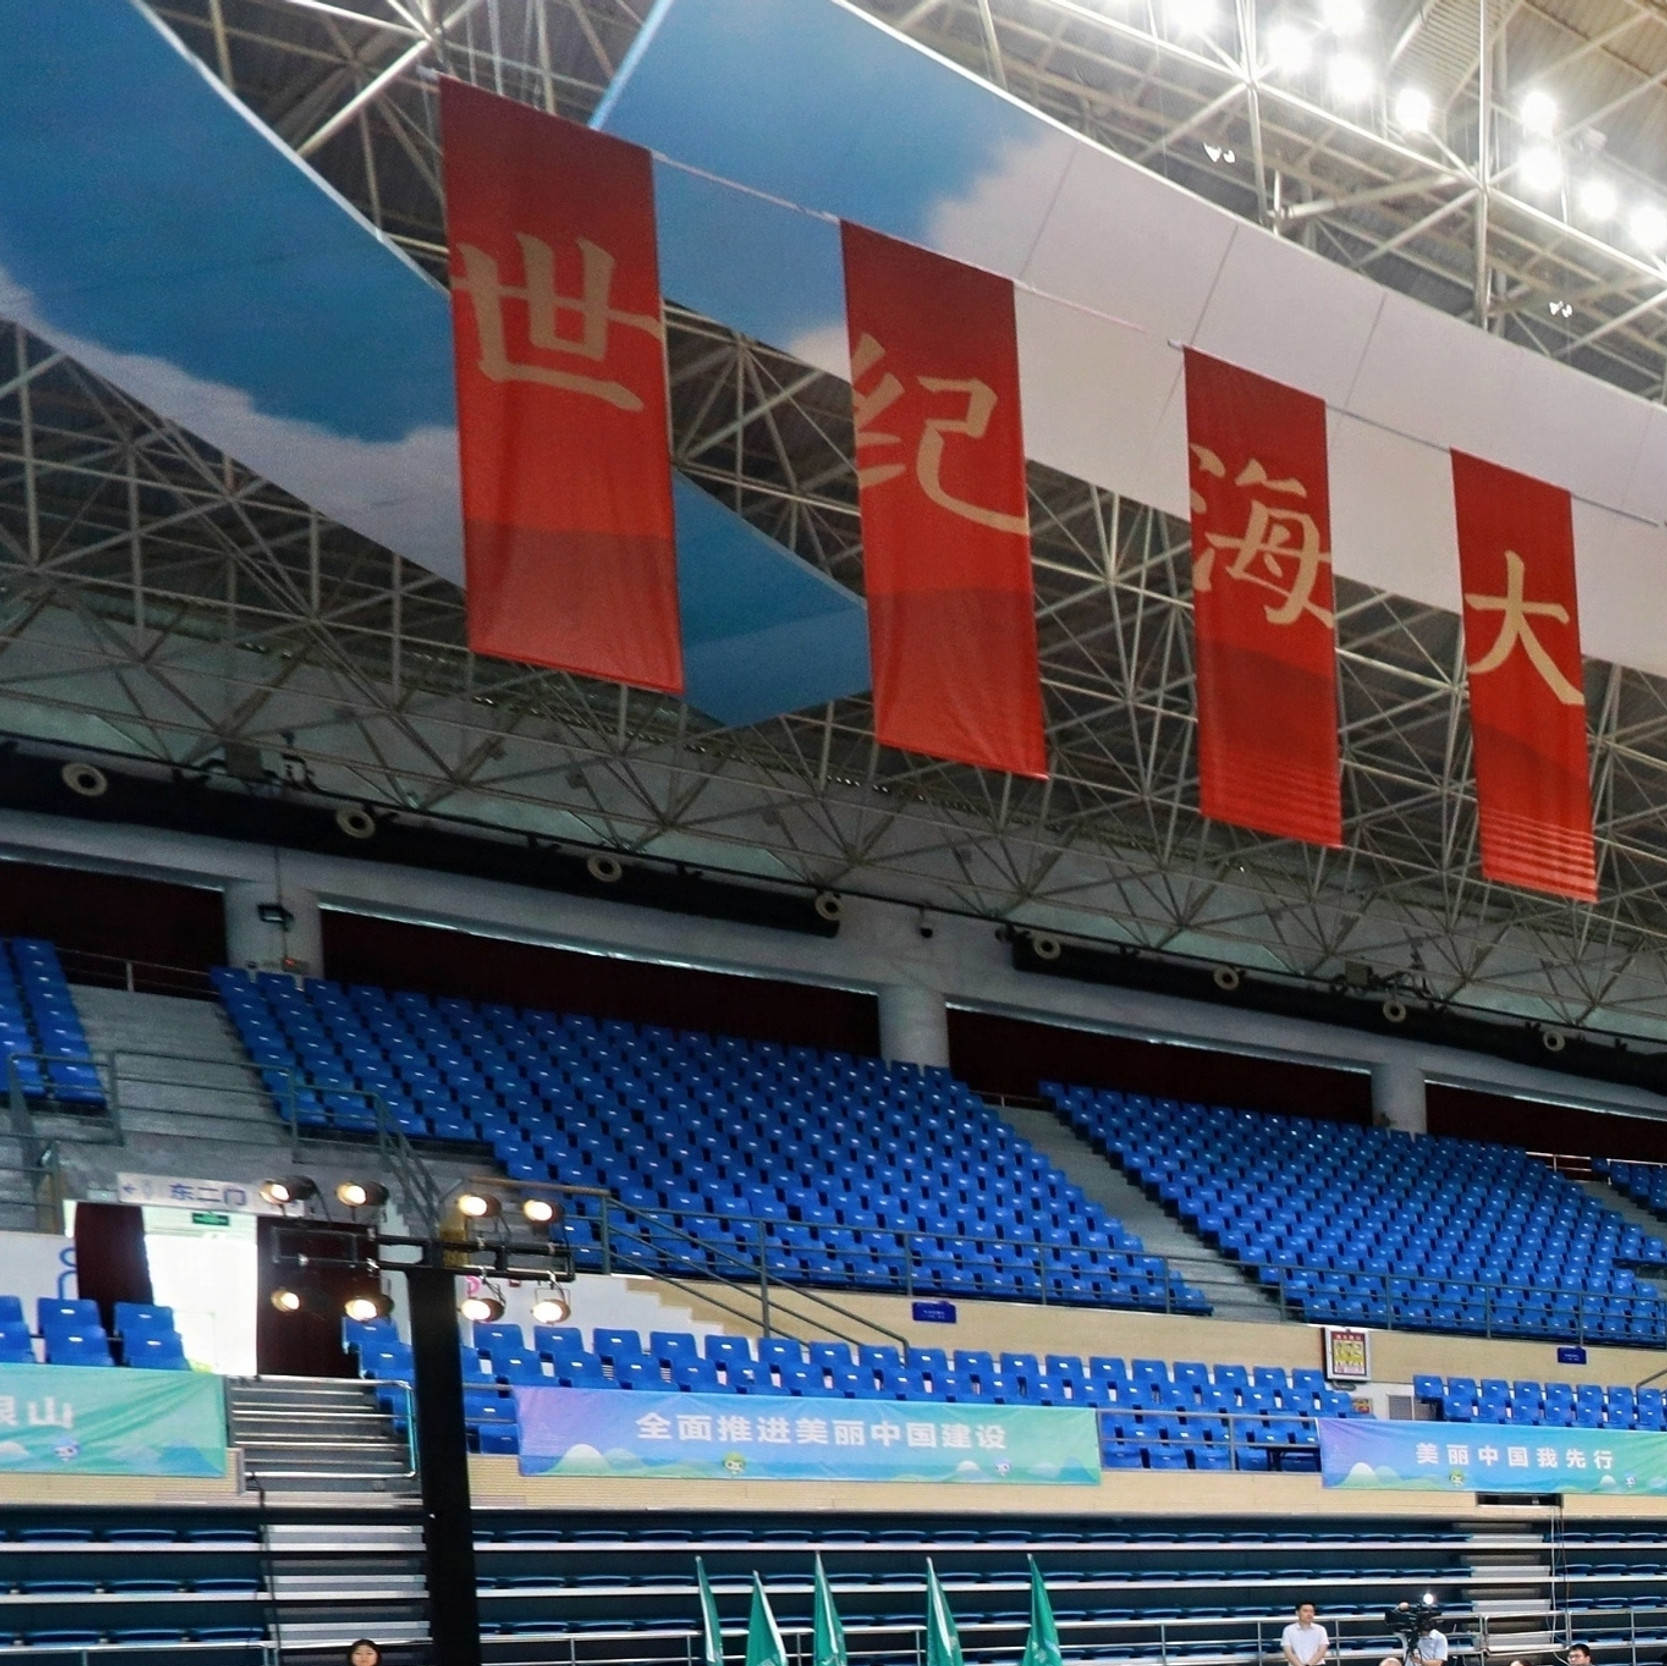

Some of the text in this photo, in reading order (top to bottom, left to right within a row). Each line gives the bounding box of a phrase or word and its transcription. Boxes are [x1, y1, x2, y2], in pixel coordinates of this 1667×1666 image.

[449, 231, 664, 413] 世
[850, 332, 1031, 537] 纪
[1189, 442, 1334, 629] 海
[1464, 550, 1586, 705] 大
[635, 1411, 1008, 1450] 全面推进美丽中国建设
[1416, 1443, 1614, 1470] 美丽中国我先行
